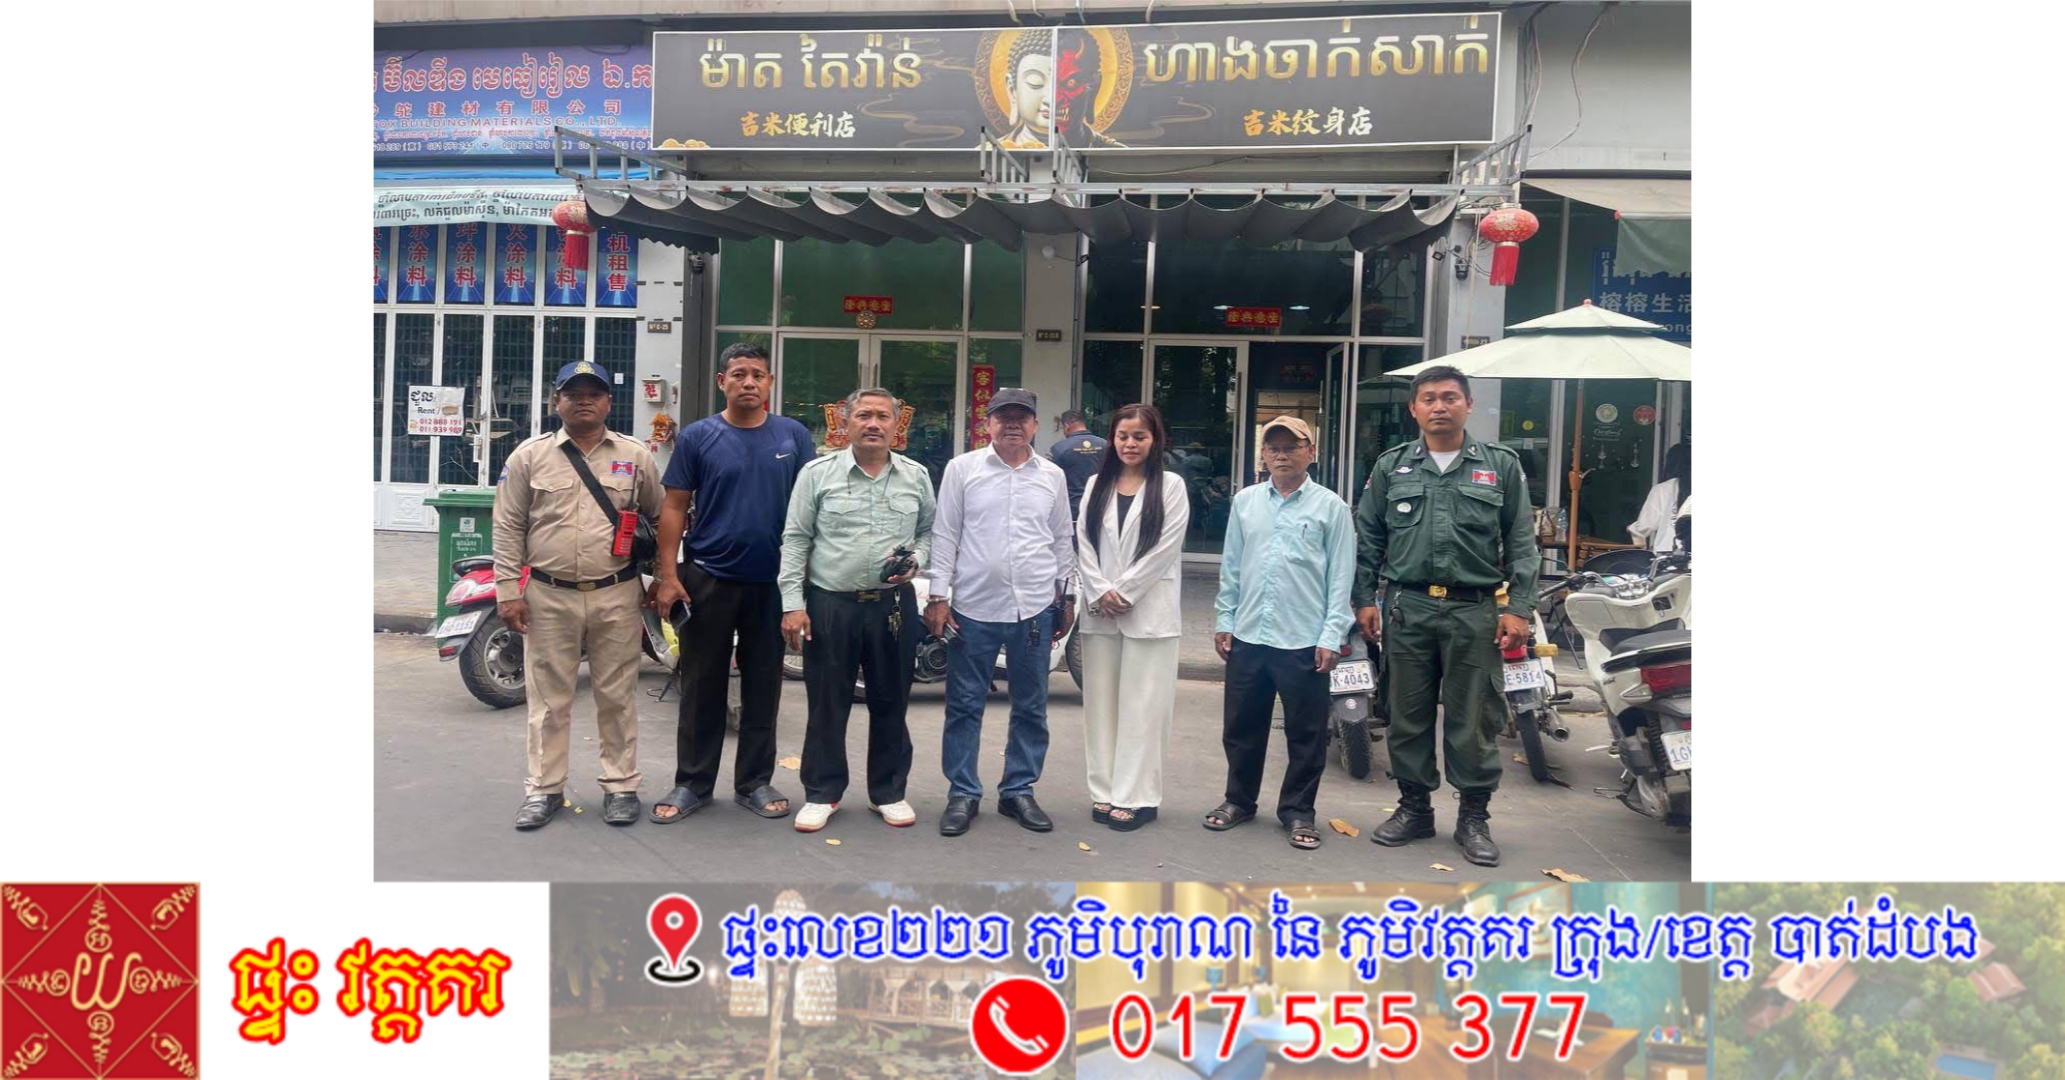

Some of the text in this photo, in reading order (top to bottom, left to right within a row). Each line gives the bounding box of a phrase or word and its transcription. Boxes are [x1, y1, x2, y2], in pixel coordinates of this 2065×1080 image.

[699, 33, 921, 88] ម៉ាត តៃវ៉ាន់
[1143, 14, 1489, 82] ហាងចាក់សាក់
[401, 119, 467, 128] BUILDING
[471, 116, 552, 127] MATERIALS
[740, 110, 857, 138] 吉米便利店
[1243, 106, 1373, 136] 吉米纹身店
